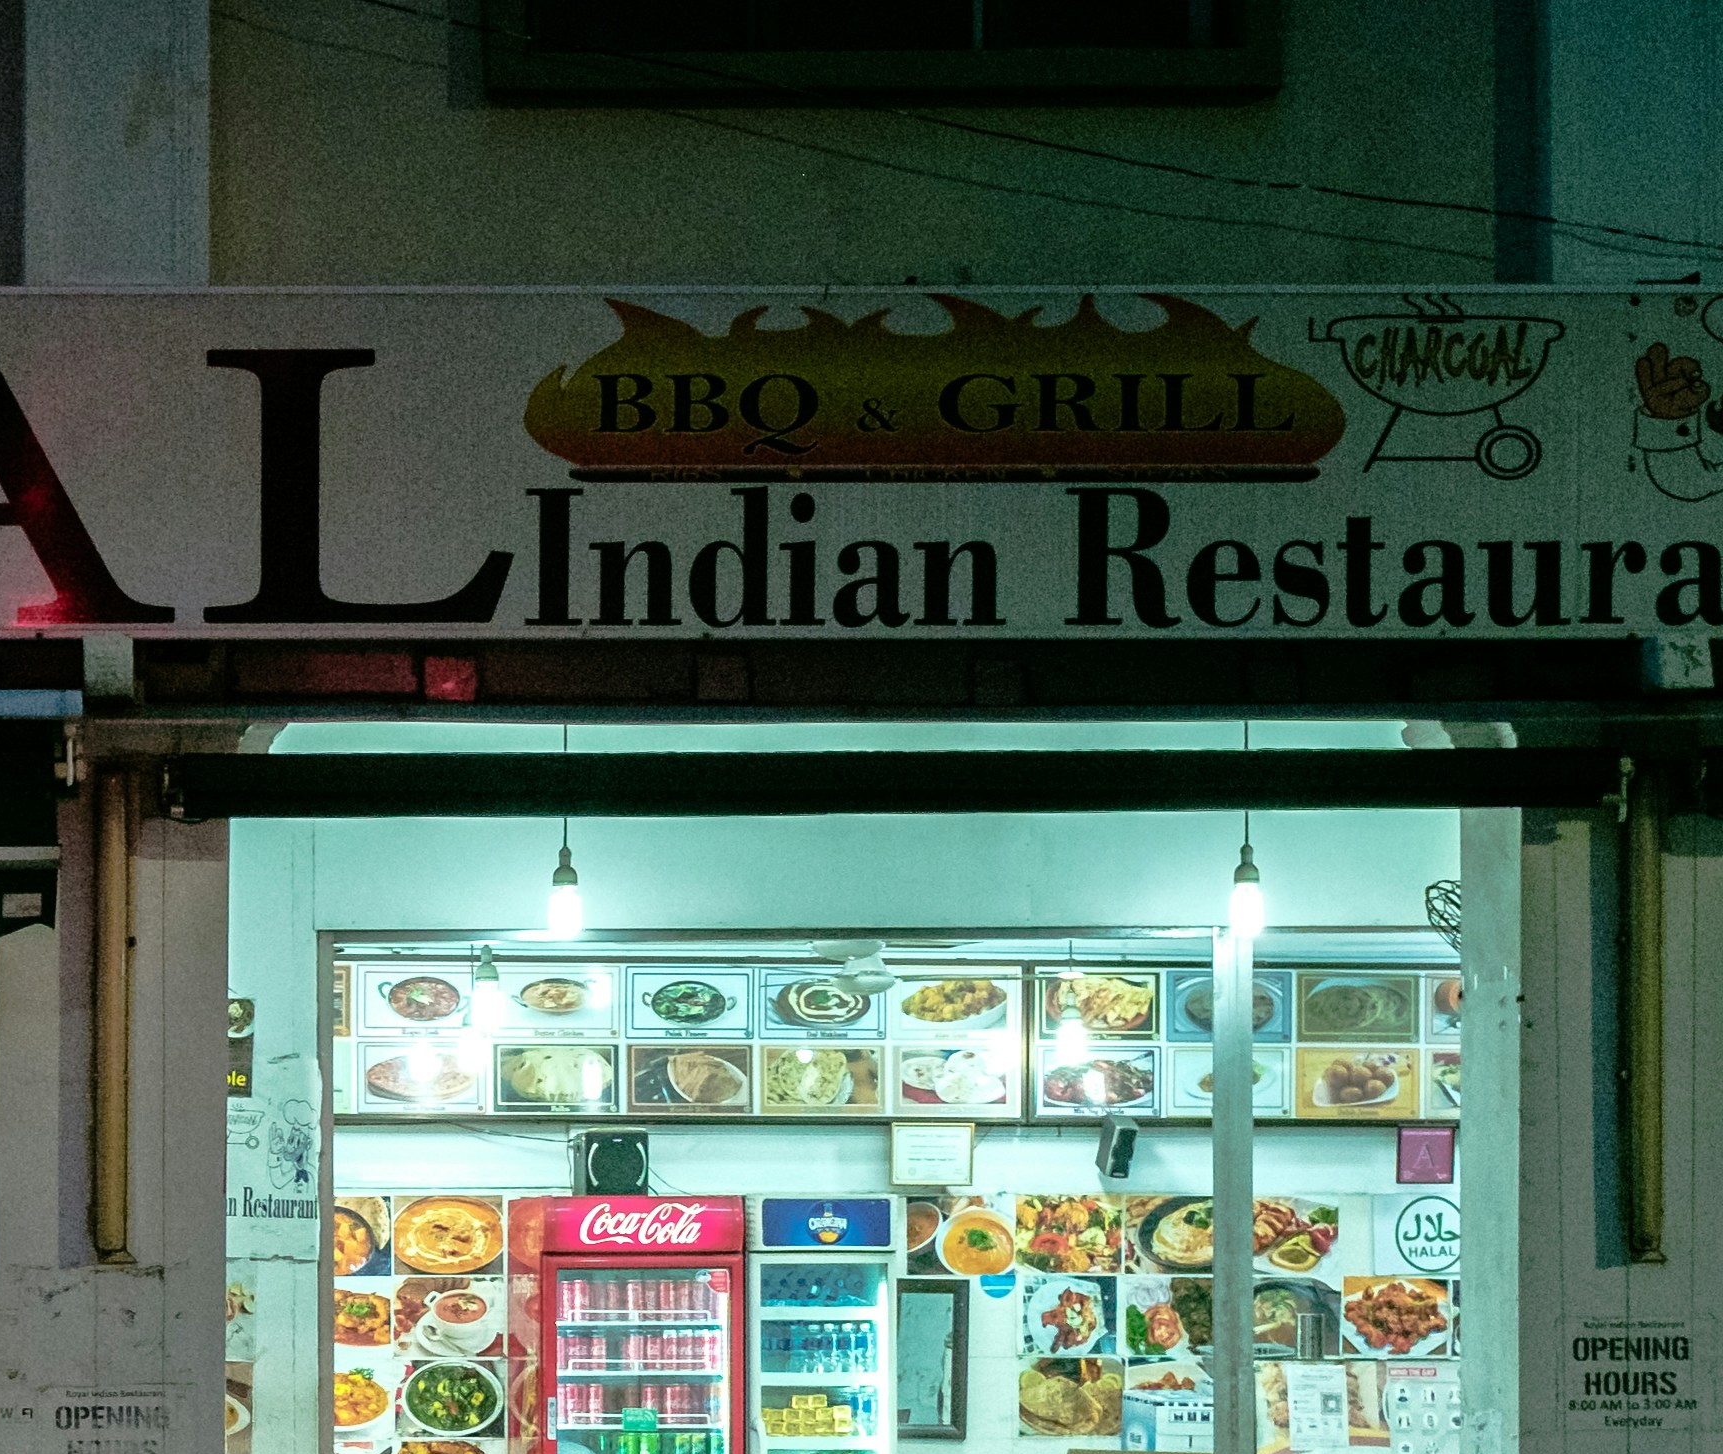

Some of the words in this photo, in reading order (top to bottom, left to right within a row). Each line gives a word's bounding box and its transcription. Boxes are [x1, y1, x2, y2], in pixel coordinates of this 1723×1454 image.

[1355, 322, 1533, 391] CHARCOAL
[591, 370, 820, 456] BBQ
[857, 398, 899, 433] &
[937, 372, 1296, 434] GRILL
[524, 485, 1007, 630] Indian
[1411, 1140, 1440, 1169] A
[579, 1202, 708, 1245] Coca-Cola
[1408, 1246, 1456, 1258] HALAL
[1572, 1336, 1690, 1362] OPENING
[1584, 1370, 1678, 1396] HOURS
[1568, 1400, 1597, 1411] 8:00
[1600, 1400, 1623, 1411] AM
[1626, 1400, 1640, 1411] to
[1642, 1399, 1672, 1410] 3:00
[1675, 1399, 1698, 1410] AM
[1604, 1415, 1664, 1429] Everyday
